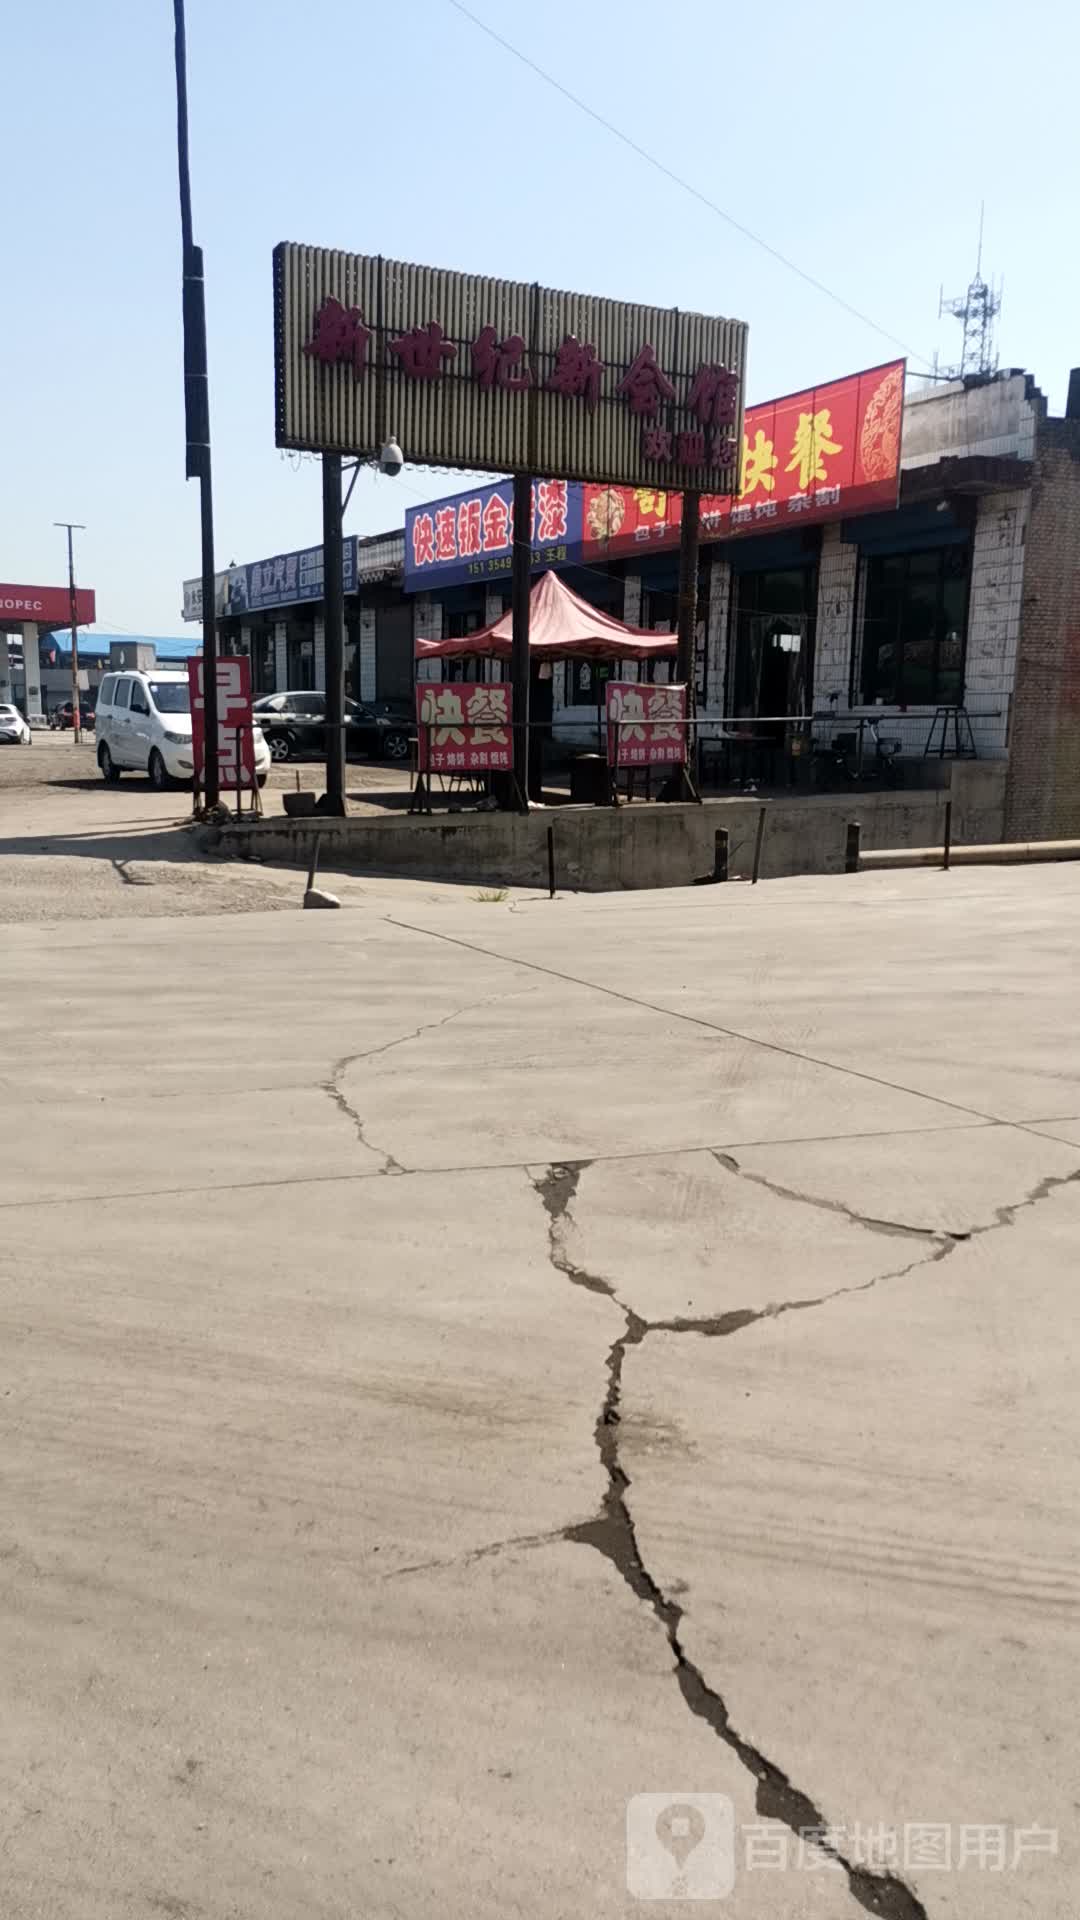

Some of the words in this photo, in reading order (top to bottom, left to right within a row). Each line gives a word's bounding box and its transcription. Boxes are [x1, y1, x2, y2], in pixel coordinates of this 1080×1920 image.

[731, 497, 777, 524] 馄饨
[420, 687, 509, 746] 快餐
[610, 688, 684, 742] 快餐
